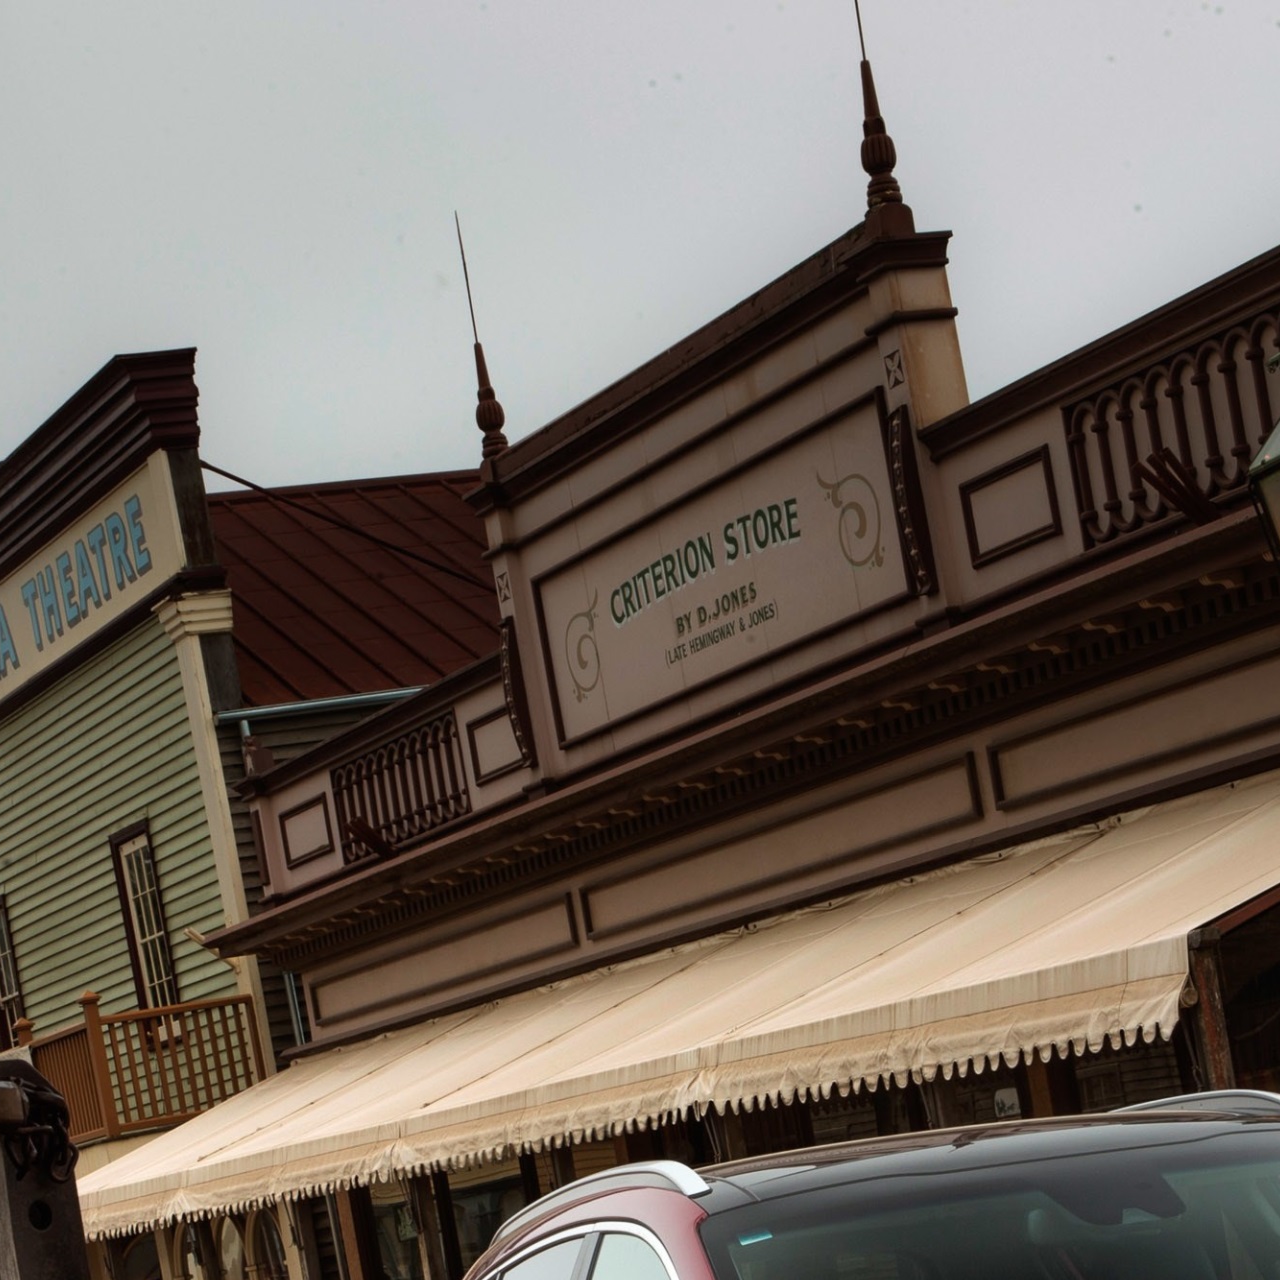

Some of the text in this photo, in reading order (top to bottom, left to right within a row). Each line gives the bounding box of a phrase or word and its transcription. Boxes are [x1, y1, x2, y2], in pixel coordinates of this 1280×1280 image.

[21, 494, 153, 651] THEATRE
[609, 497, 802, 626] CRITERION STORE
[675, 610, 692, 636] BY
[689, 620, 736, 655] HEMINGWAY
[738, 616, 746, 632] &
